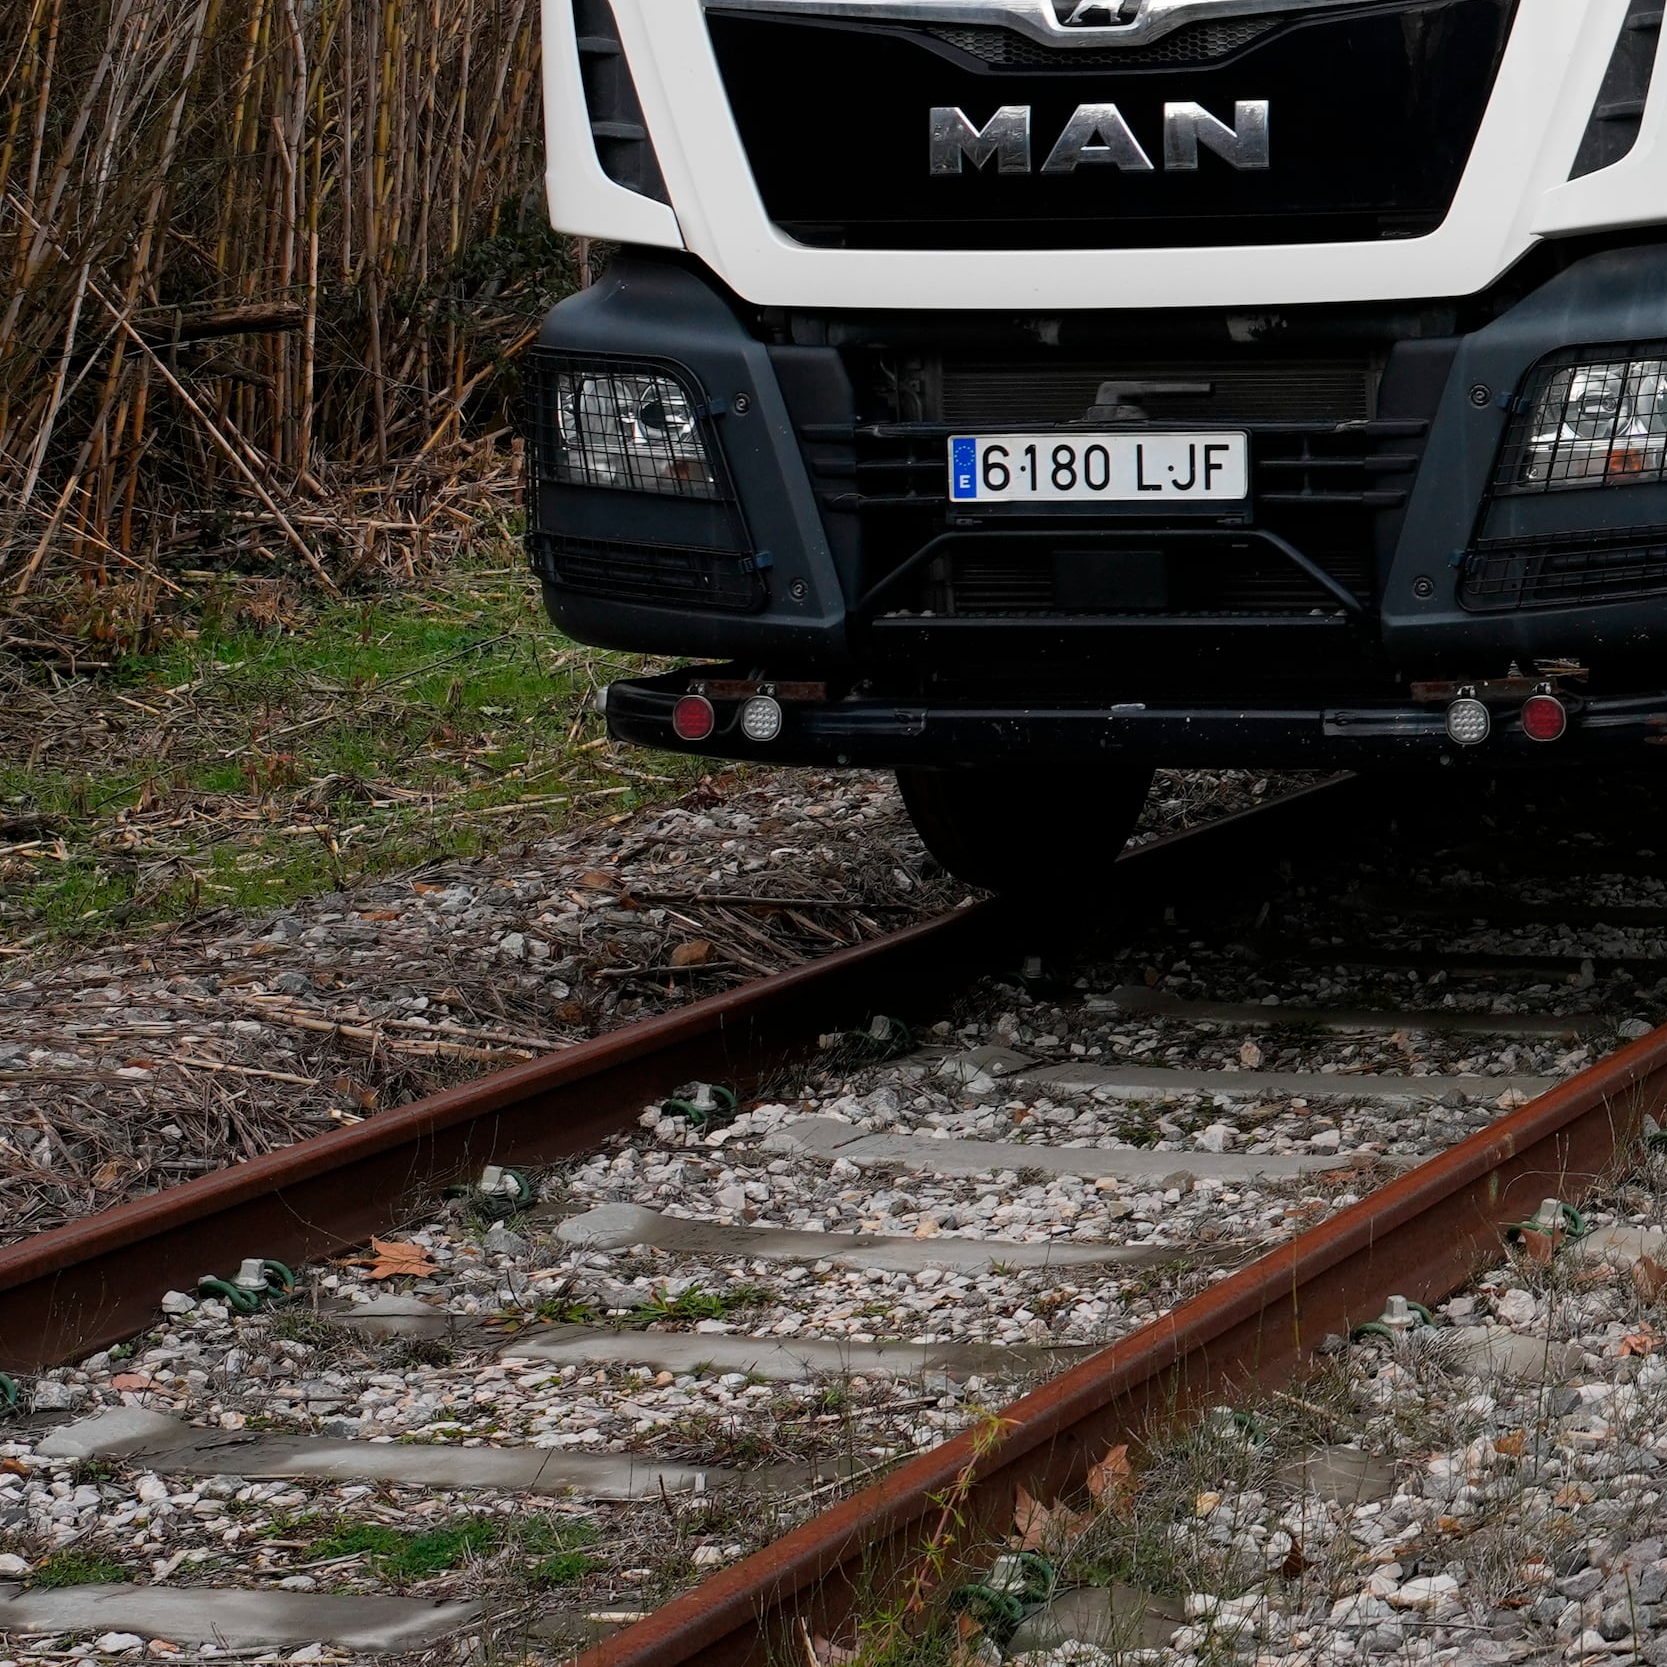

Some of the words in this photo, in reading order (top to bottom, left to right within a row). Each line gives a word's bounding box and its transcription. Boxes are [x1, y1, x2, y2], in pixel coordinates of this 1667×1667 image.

[930, 100, 1269, 174] MAN
[959, 475, 971, 488] E
[982, 444, 1110, 491] 6180
[1137, 444, 1230, 491] LJF
